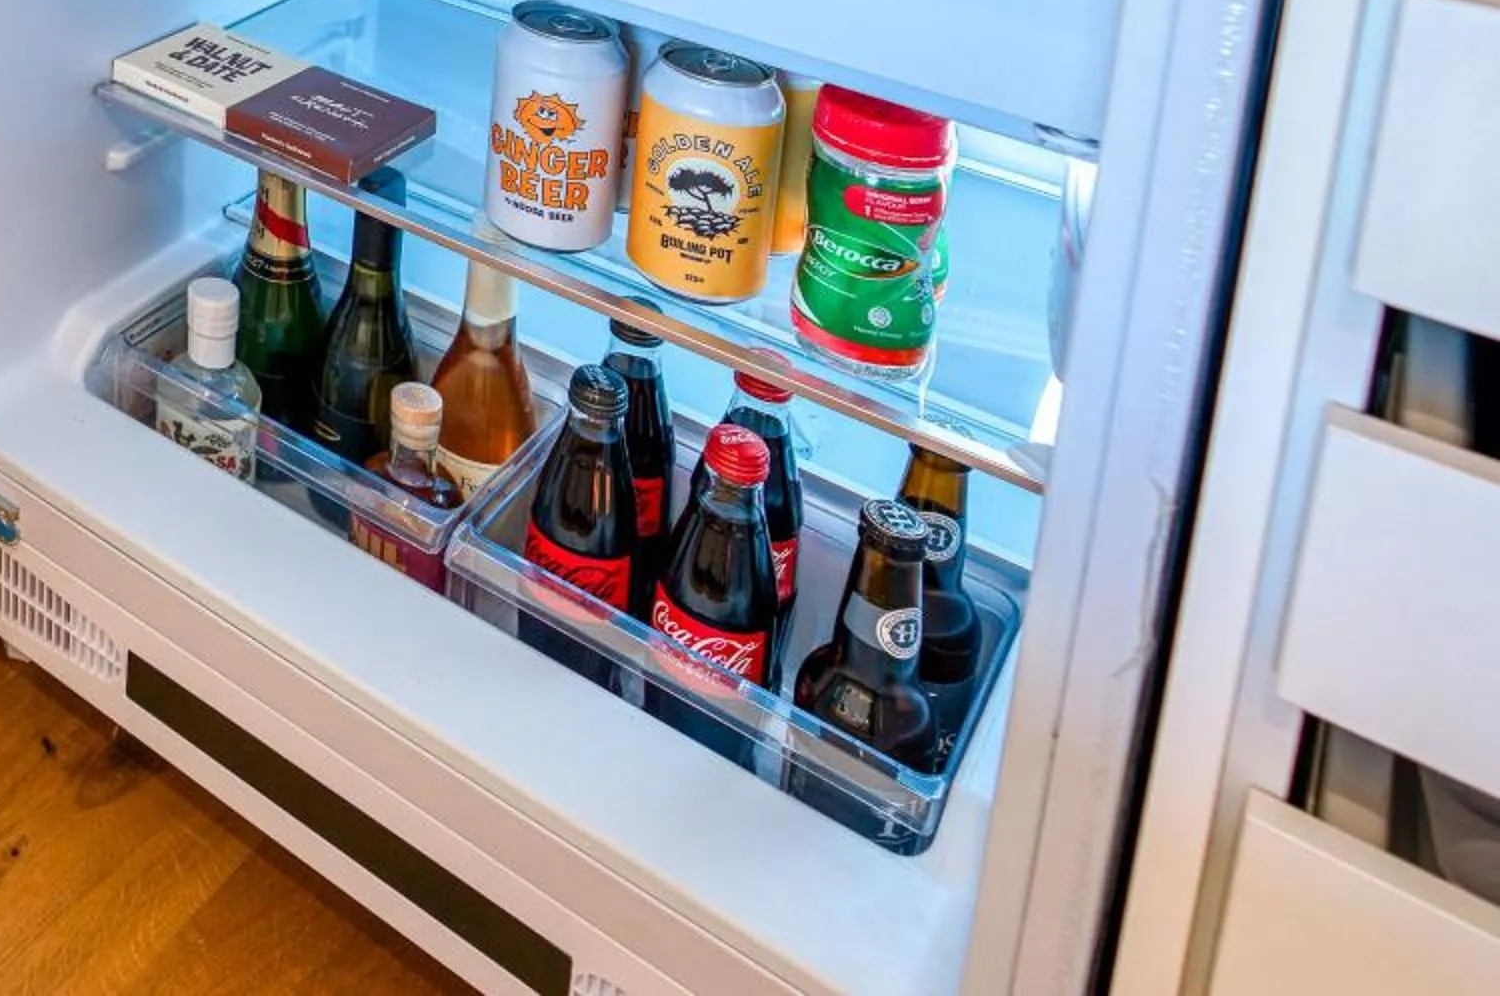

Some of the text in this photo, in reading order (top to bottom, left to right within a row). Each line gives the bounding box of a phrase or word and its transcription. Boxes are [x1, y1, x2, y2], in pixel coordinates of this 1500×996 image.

[185, 37, 274, 75] WALNUT
[185, 55, 248, 82] DATE
[491, 123, 609, 180] GINGER
[647, 133, 763, 198] GOLDEN ALE
[499, 159, 589, 212] BEER
[709, 247, 733, 264] POT
[814, 229, 901, 272] Berocca
